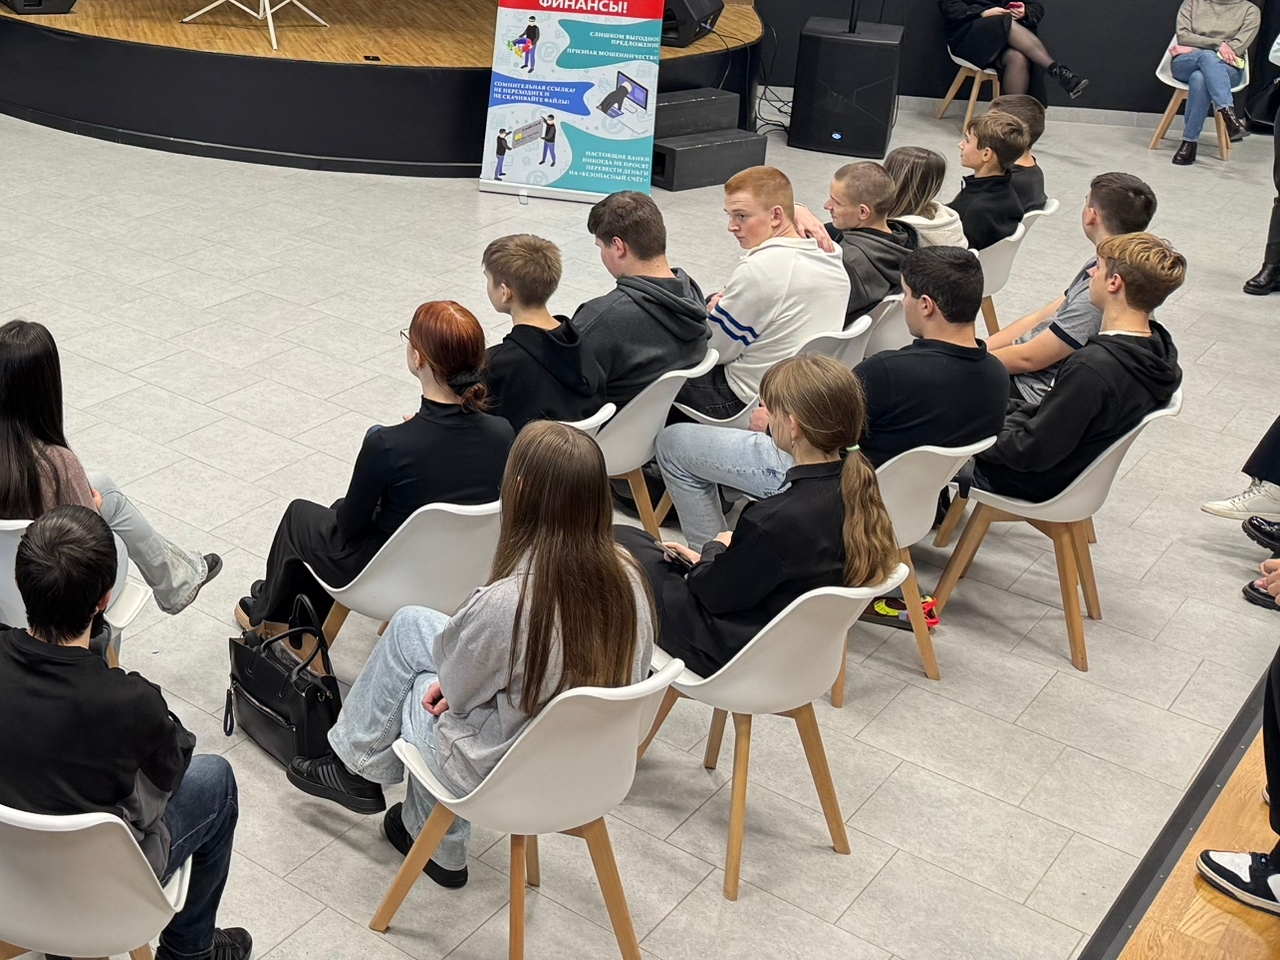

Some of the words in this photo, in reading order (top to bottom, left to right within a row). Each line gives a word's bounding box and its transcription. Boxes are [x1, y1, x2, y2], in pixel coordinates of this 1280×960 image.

[494, 82, 546, 90] СОМНИТЕЛЬНАЯ
[503, 88, 543, 97] ПЕРЕХОДИТЕ
[586, 151, 626, 160] НАСТОЯЩИЕ
[586, 165, 622, 173] ПЕРЕВЕСТИ
